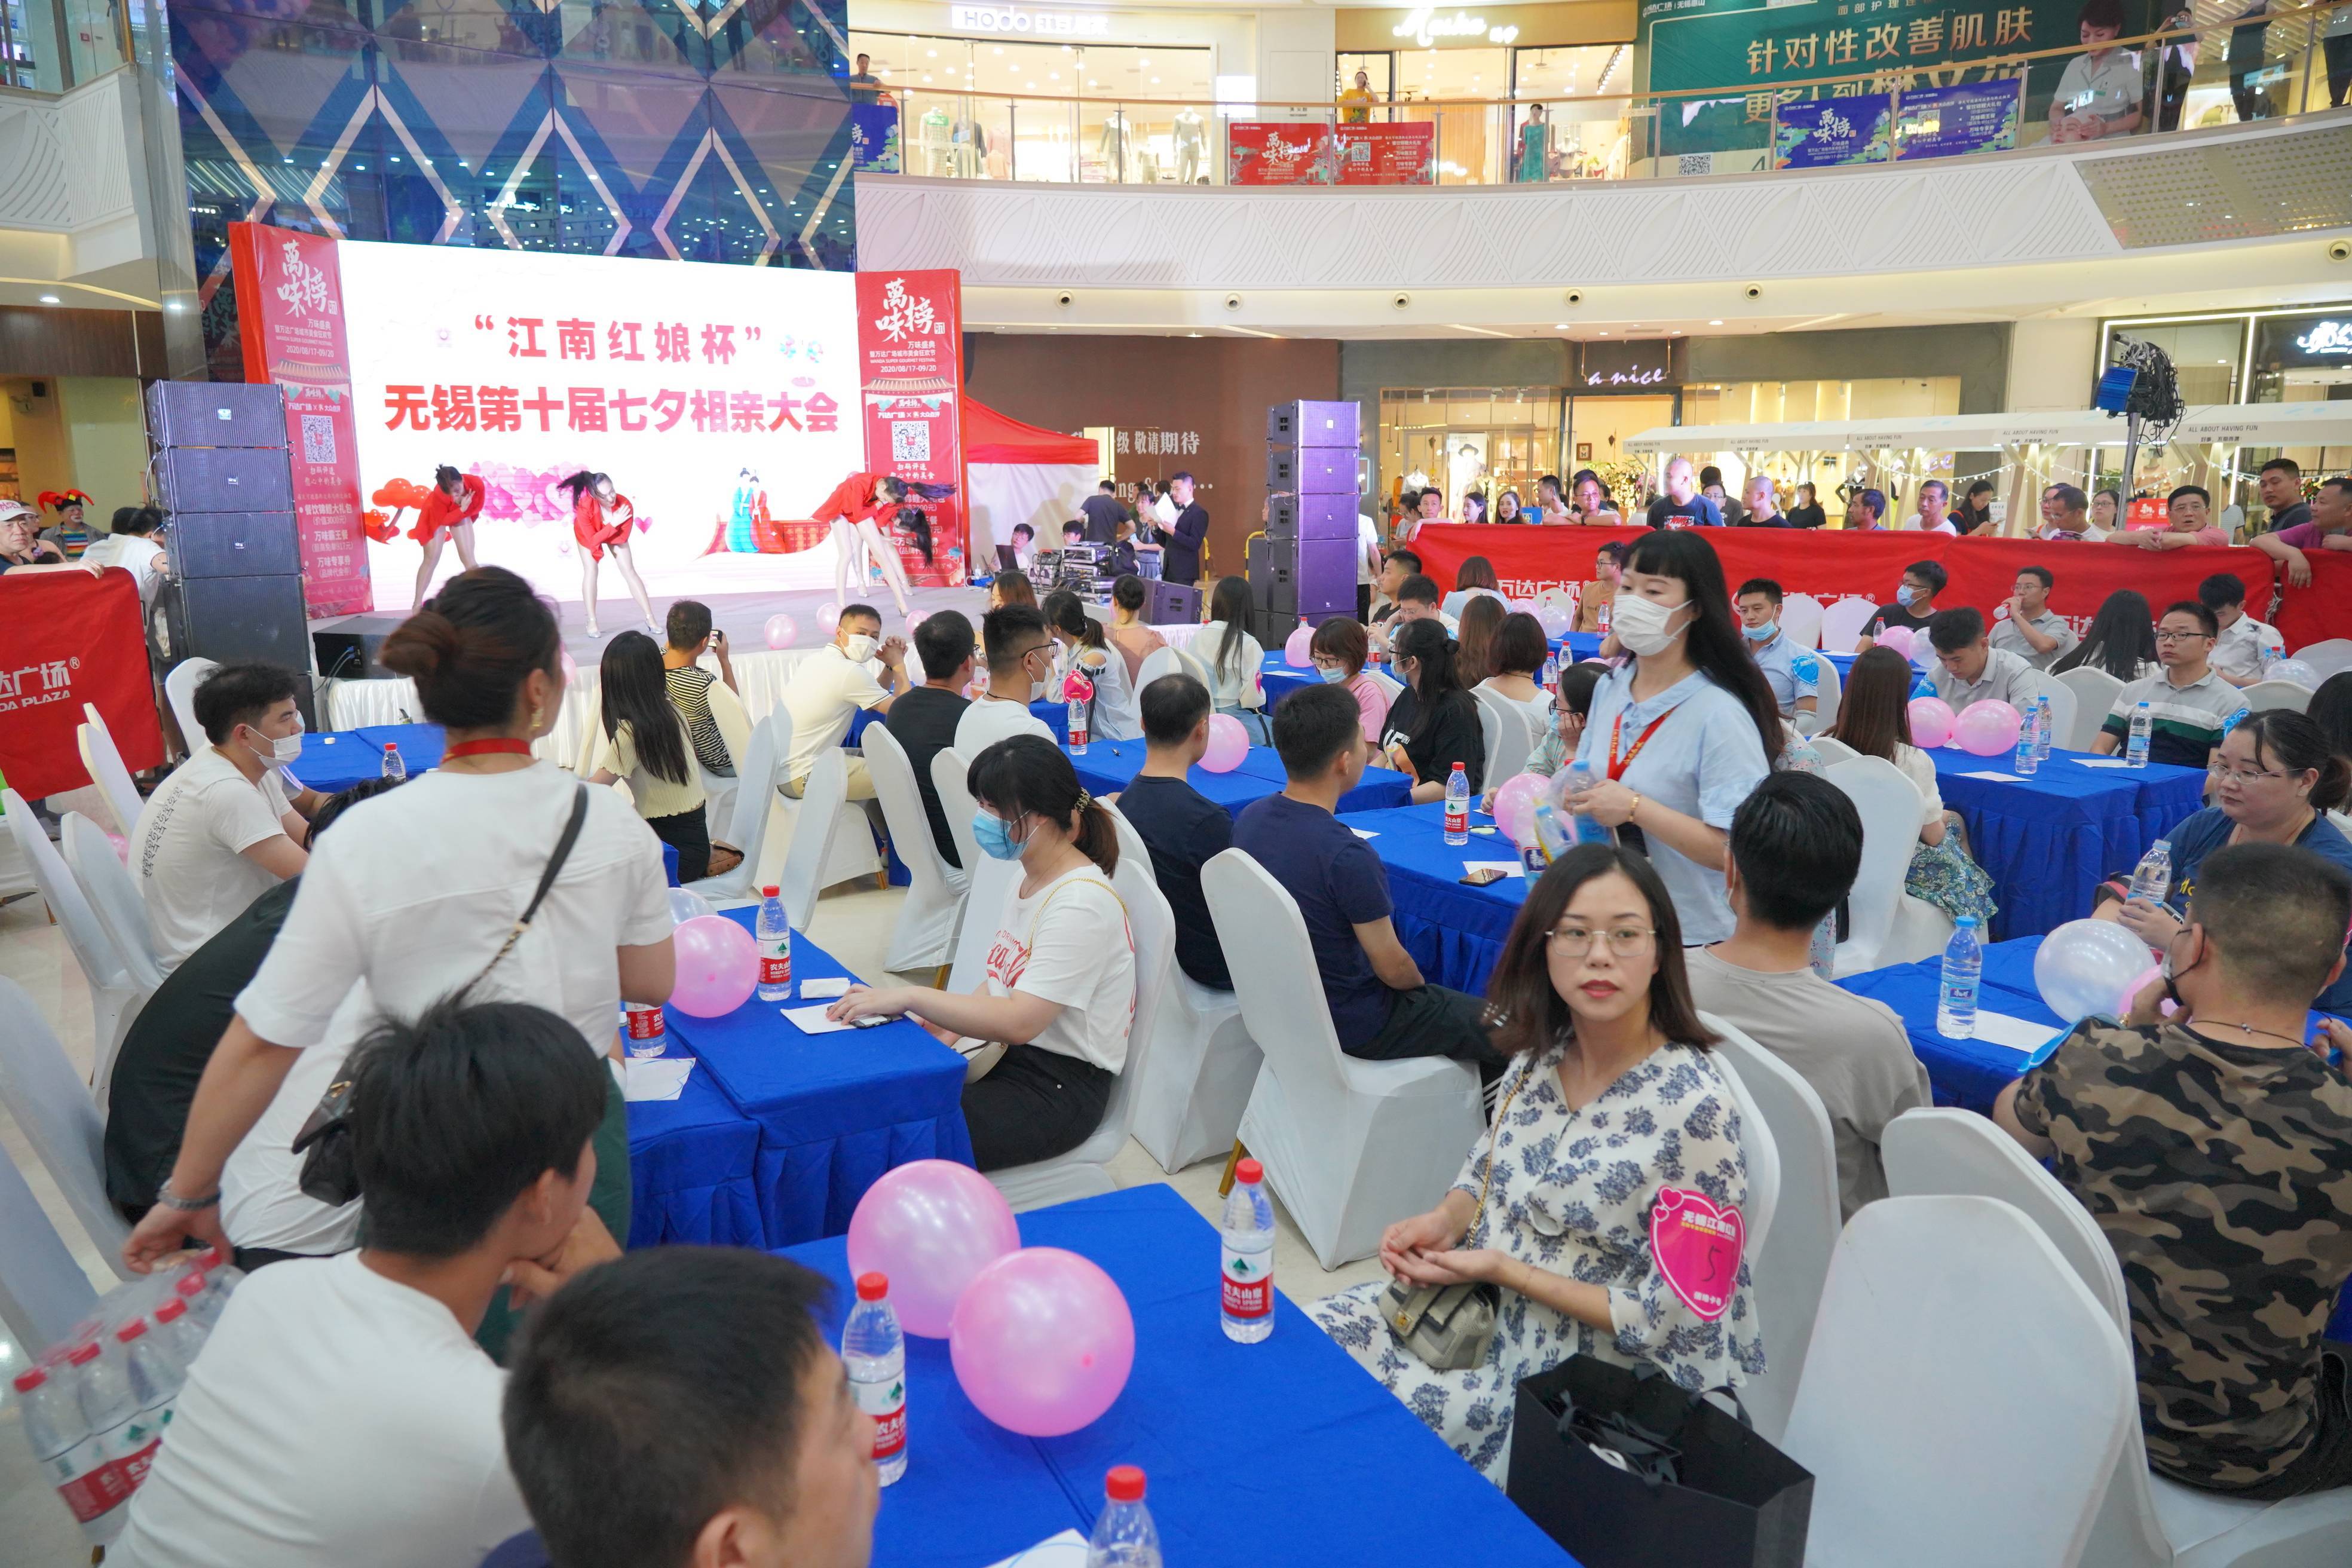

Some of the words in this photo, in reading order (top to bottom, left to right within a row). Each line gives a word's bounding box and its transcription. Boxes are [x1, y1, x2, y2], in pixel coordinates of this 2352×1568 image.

[1747, 7, 2033, 75] 针对性改善肌肤
[384, 384, 838, 434] 无锡第十届七夕相亲大会
[1134, 431, 1200, 455] 敬请期待
[23, 690, 71, 708] PLAZA
